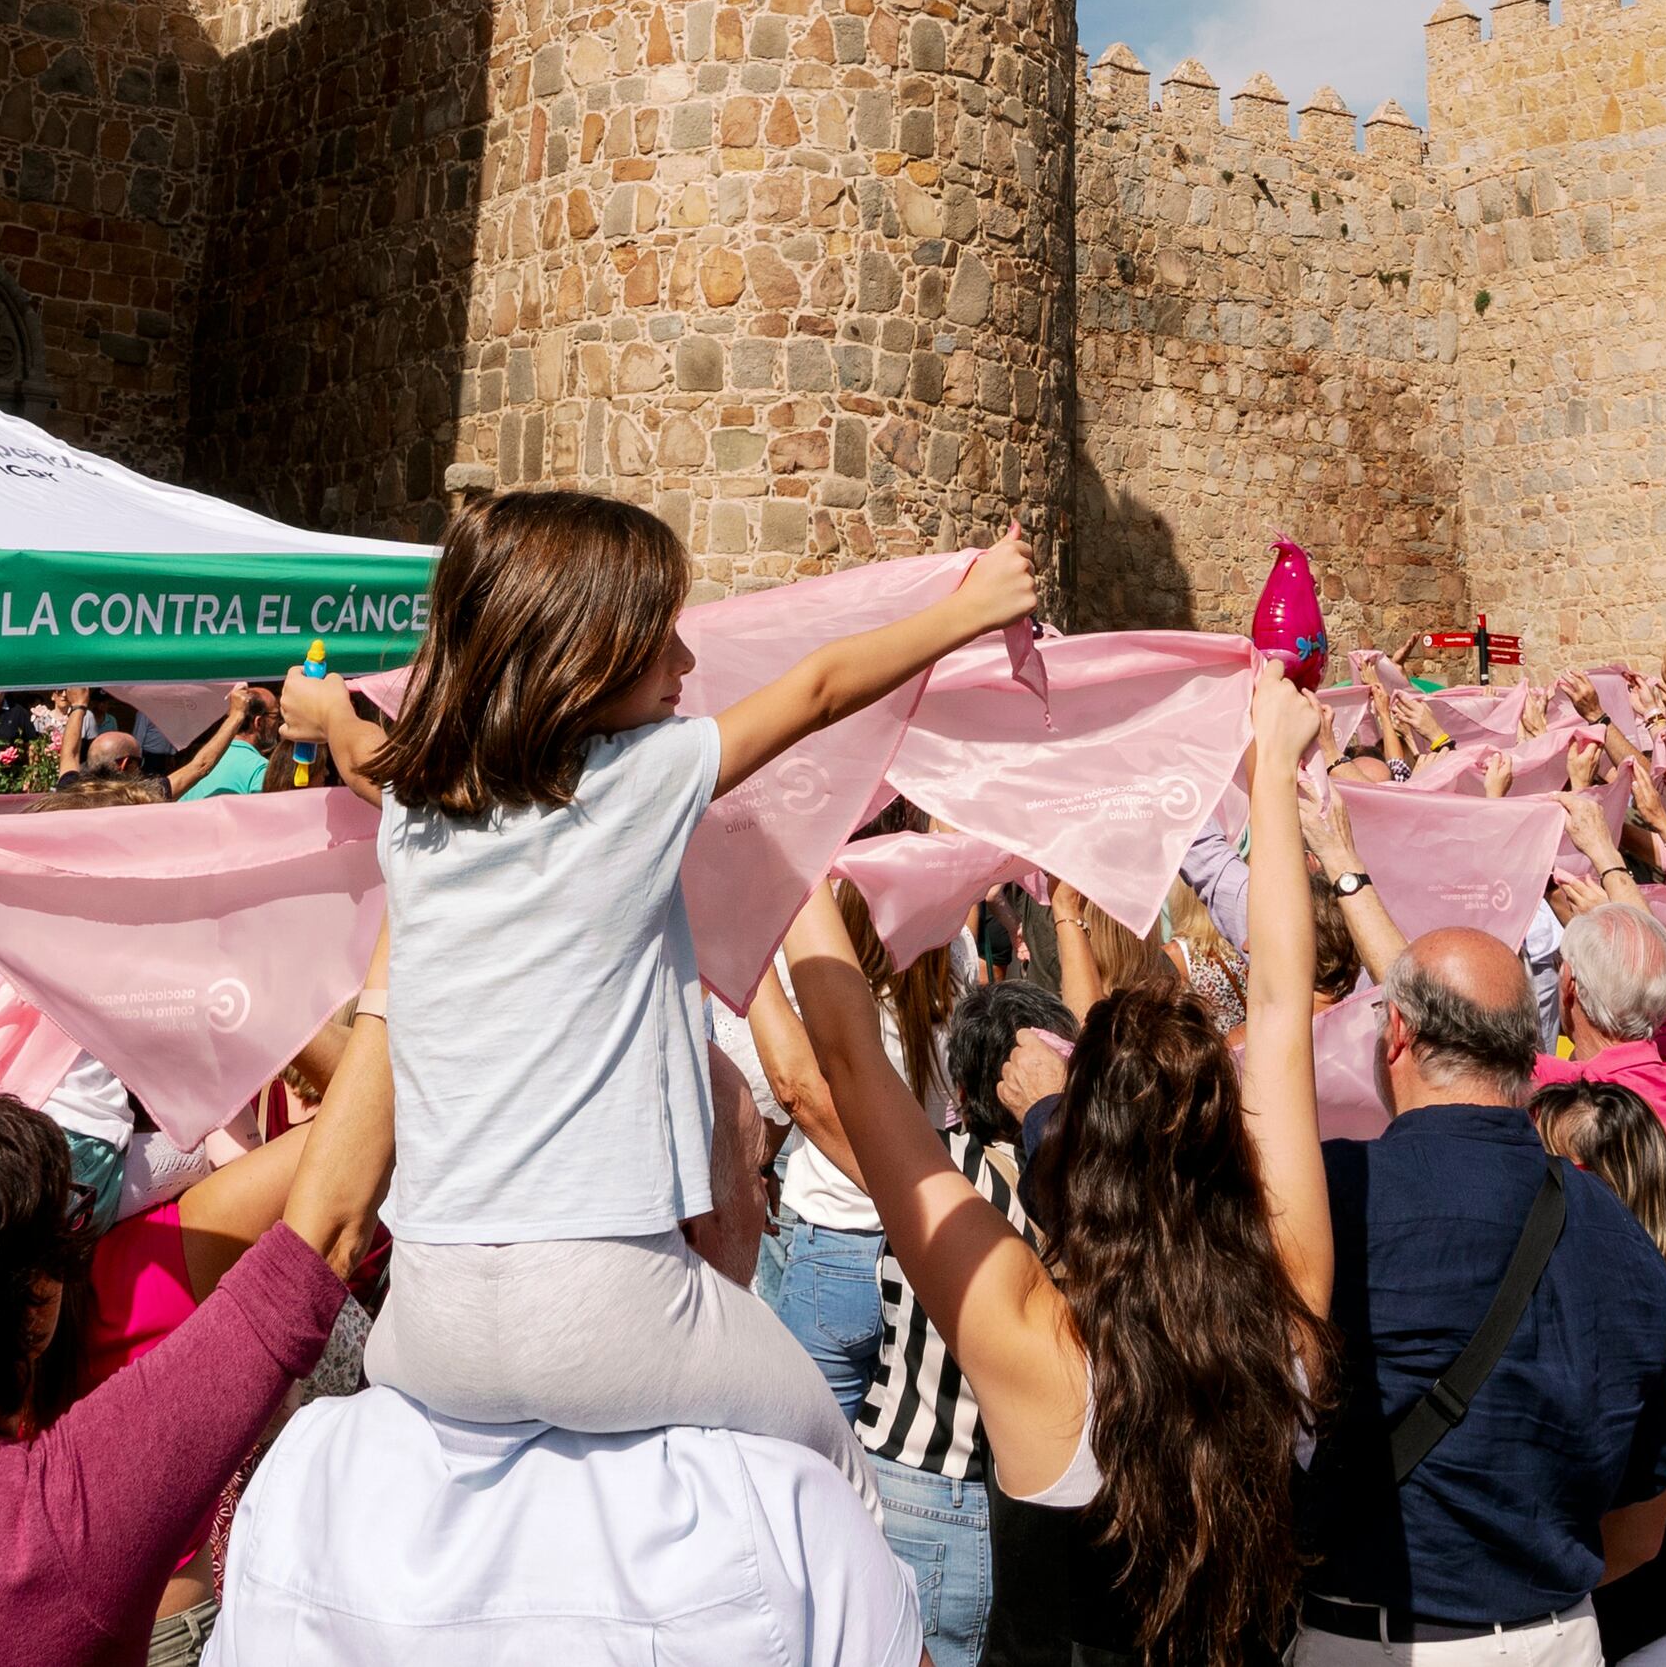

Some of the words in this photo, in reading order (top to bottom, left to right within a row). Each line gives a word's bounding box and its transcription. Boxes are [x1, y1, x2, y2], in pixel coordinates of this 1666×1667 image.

[70, 591, 246, 635] CONTRA
[256, 594, 301, 634] EL
[310, 584, 431, 632] CÁNCE
